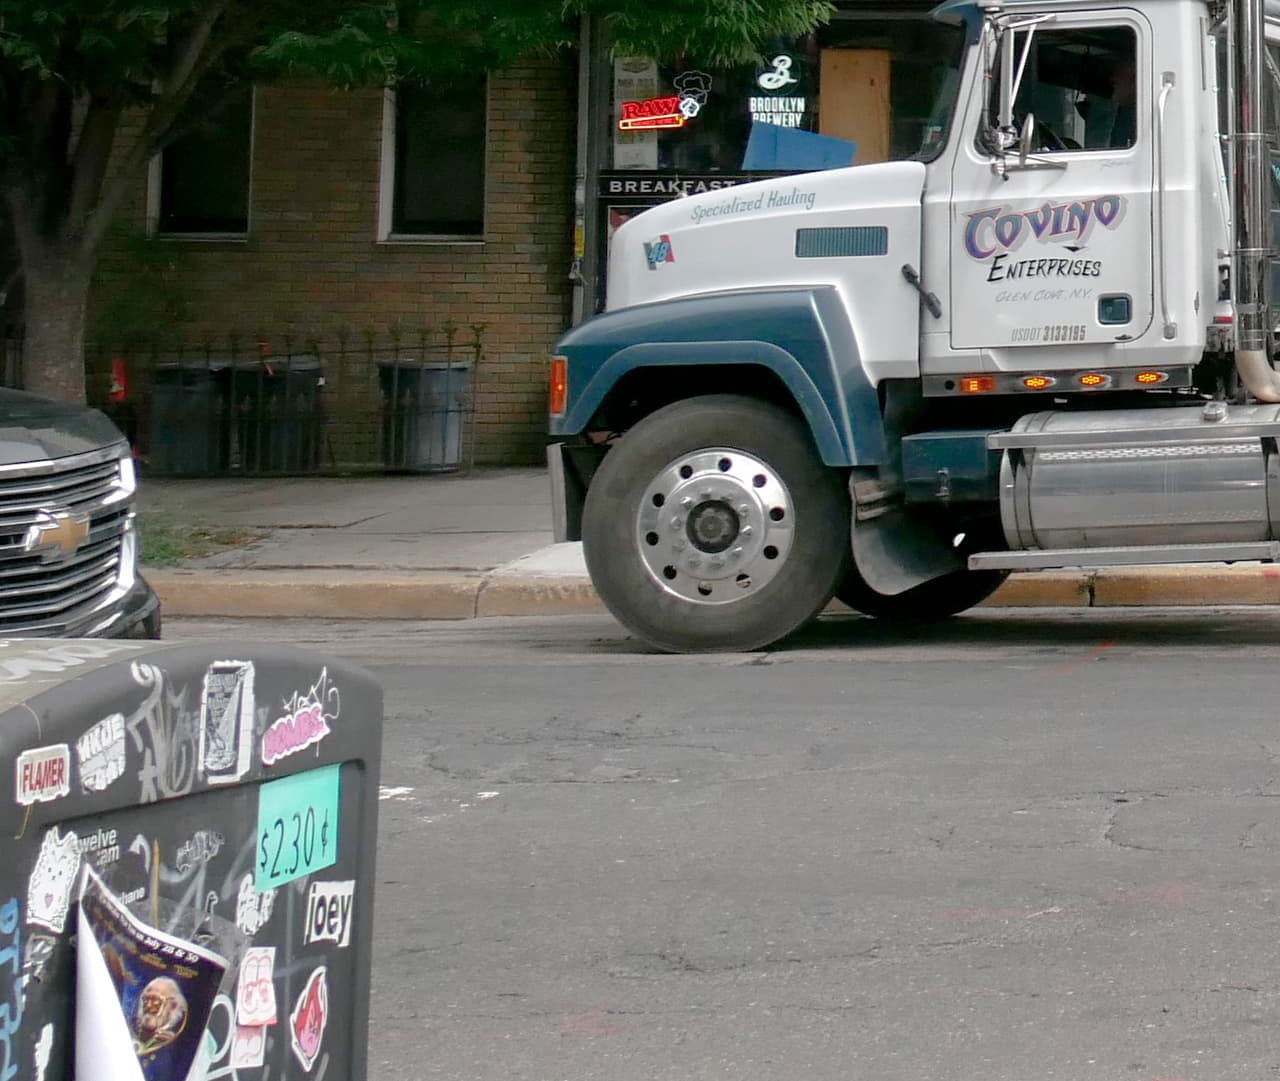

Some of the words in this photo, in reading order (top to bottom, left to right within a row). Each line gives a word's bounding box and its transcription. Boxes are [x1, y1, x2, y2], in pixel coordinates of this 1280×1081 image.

[620, 97, 680, 120] RAW
[750, 97, 805, 113] BROOKLYN
[690, 192, 764, 224] Specialized
[767, 187, 816, 210] Hauling
[965, 194, 1121, 259] COVINO
[987, 253, 1102, 282] ENTERPRISES
[995, 291, 1031, 303] GLEN
[1011, 327, 1042, 342] USDOT
[23, 758, 65, 795] FLAMER
[80, 829, 117, 853] welve
[260, 806, 315, 880] $2.30
[305, 881, 353, 945] joey
[145, 937, 162, 950] July
